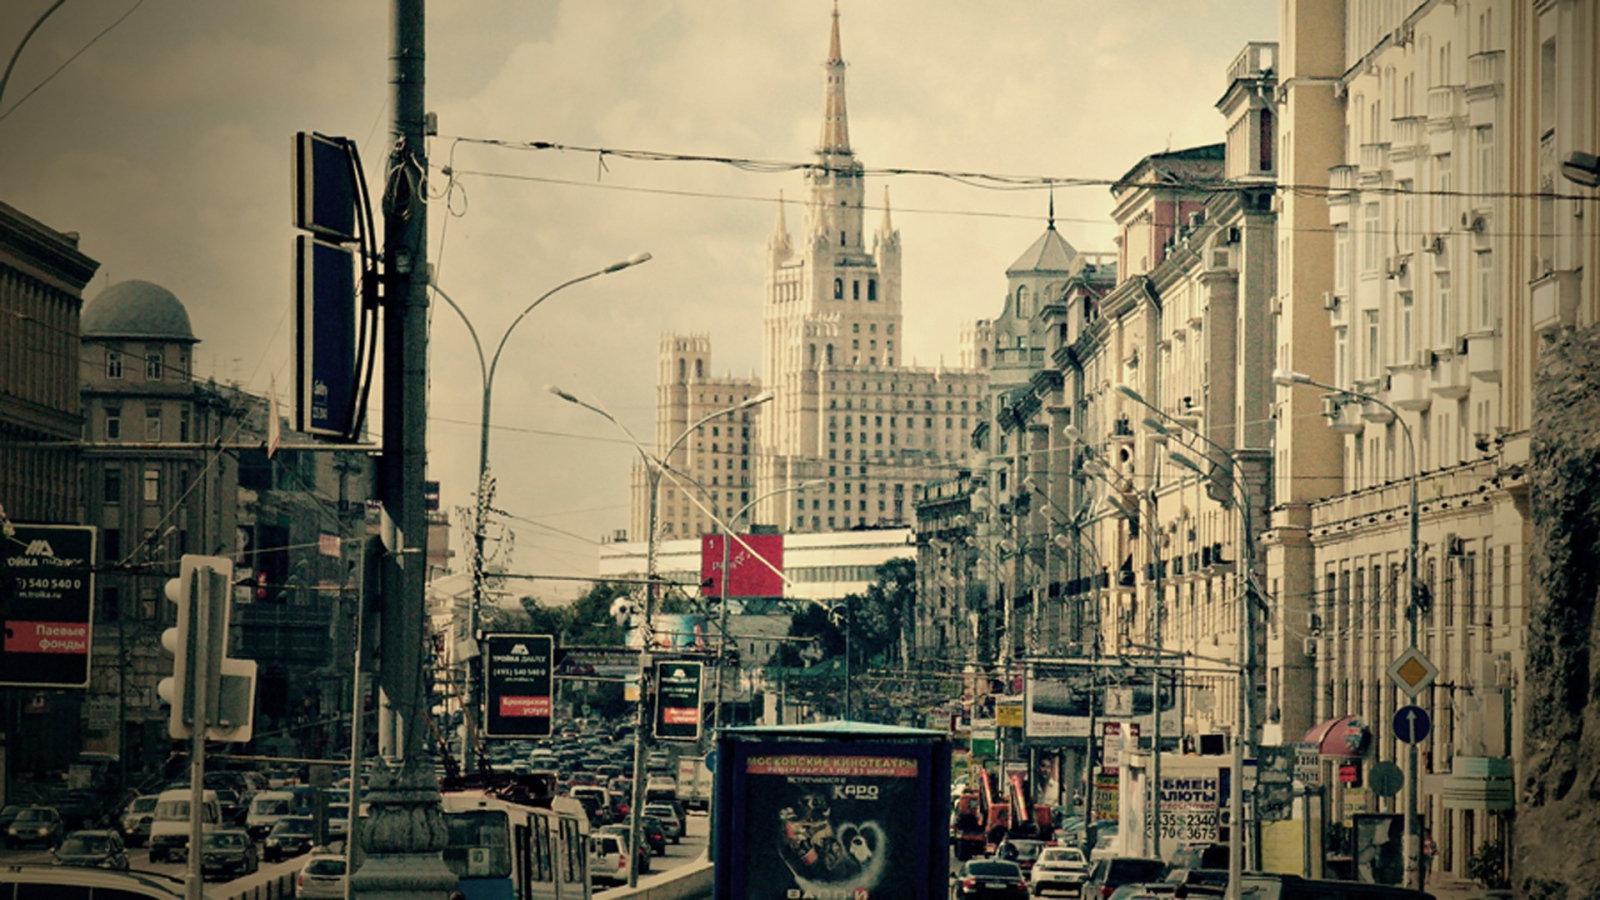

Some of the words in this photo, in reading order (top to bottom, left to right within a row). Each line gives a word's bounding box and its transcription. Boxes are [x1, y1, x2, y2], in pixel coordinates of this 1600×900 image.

[7, 557, 38, 567] ОЙКА
[28, 578, 49, 588] 540
[51, 578, 71, 589] 540
[73, 579, 81, 589] 0
[36, 624, 86, 637] Паевые
[39, 637, 86, 651] фонды
[746, 757, 829, 766] МОСКОВСКИЕ
[833, 758, 918, 768] КИНОТЕАТРЫ
[832, 784, 879, 799] КАРО
[1147, 814, 1176, 826] 235
[1187, 814, 1217, 826] 2340
[1187, 827, 1216, 840] 3675
